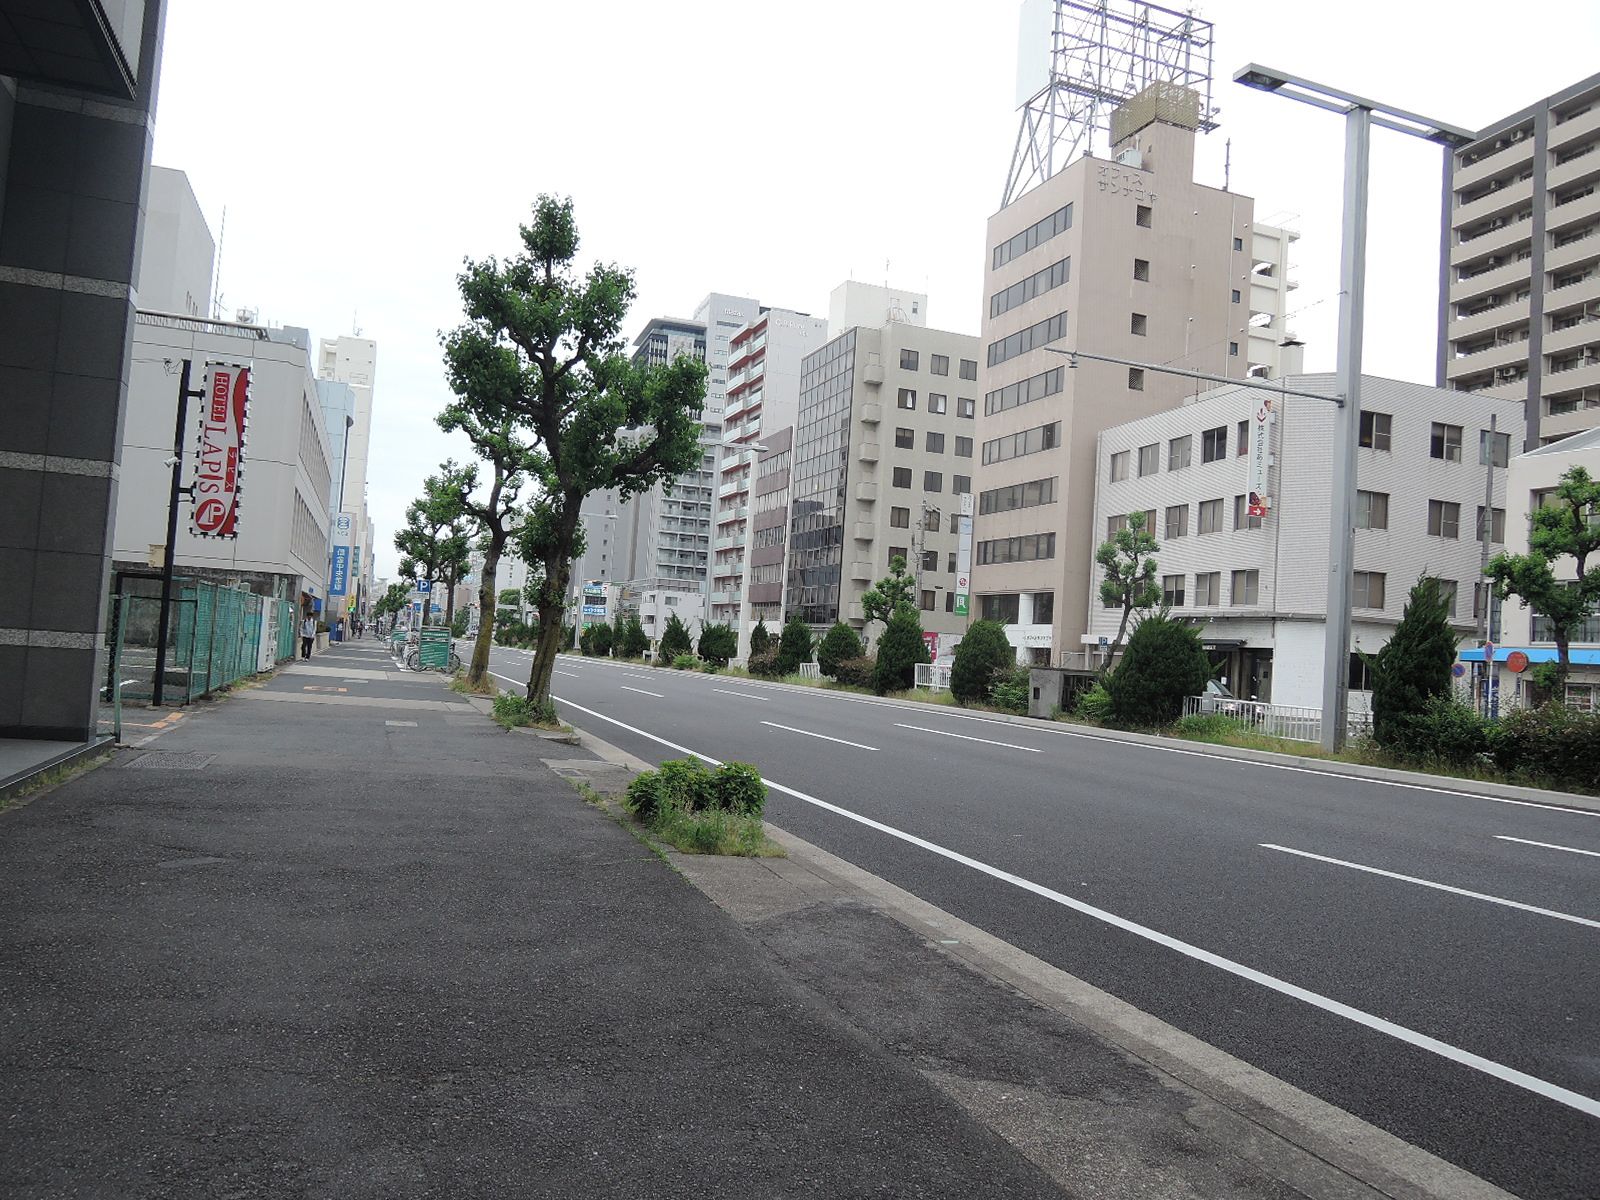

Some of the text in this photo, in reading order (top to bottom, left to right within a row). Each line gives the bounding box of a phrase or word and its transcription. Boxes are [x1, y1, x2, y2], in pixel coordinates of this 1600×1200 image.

[212, 375, 229, 420] HOTEL
[198, 423, 228, 494] LAPIS
[225, 451, 237, 489] ラピス
